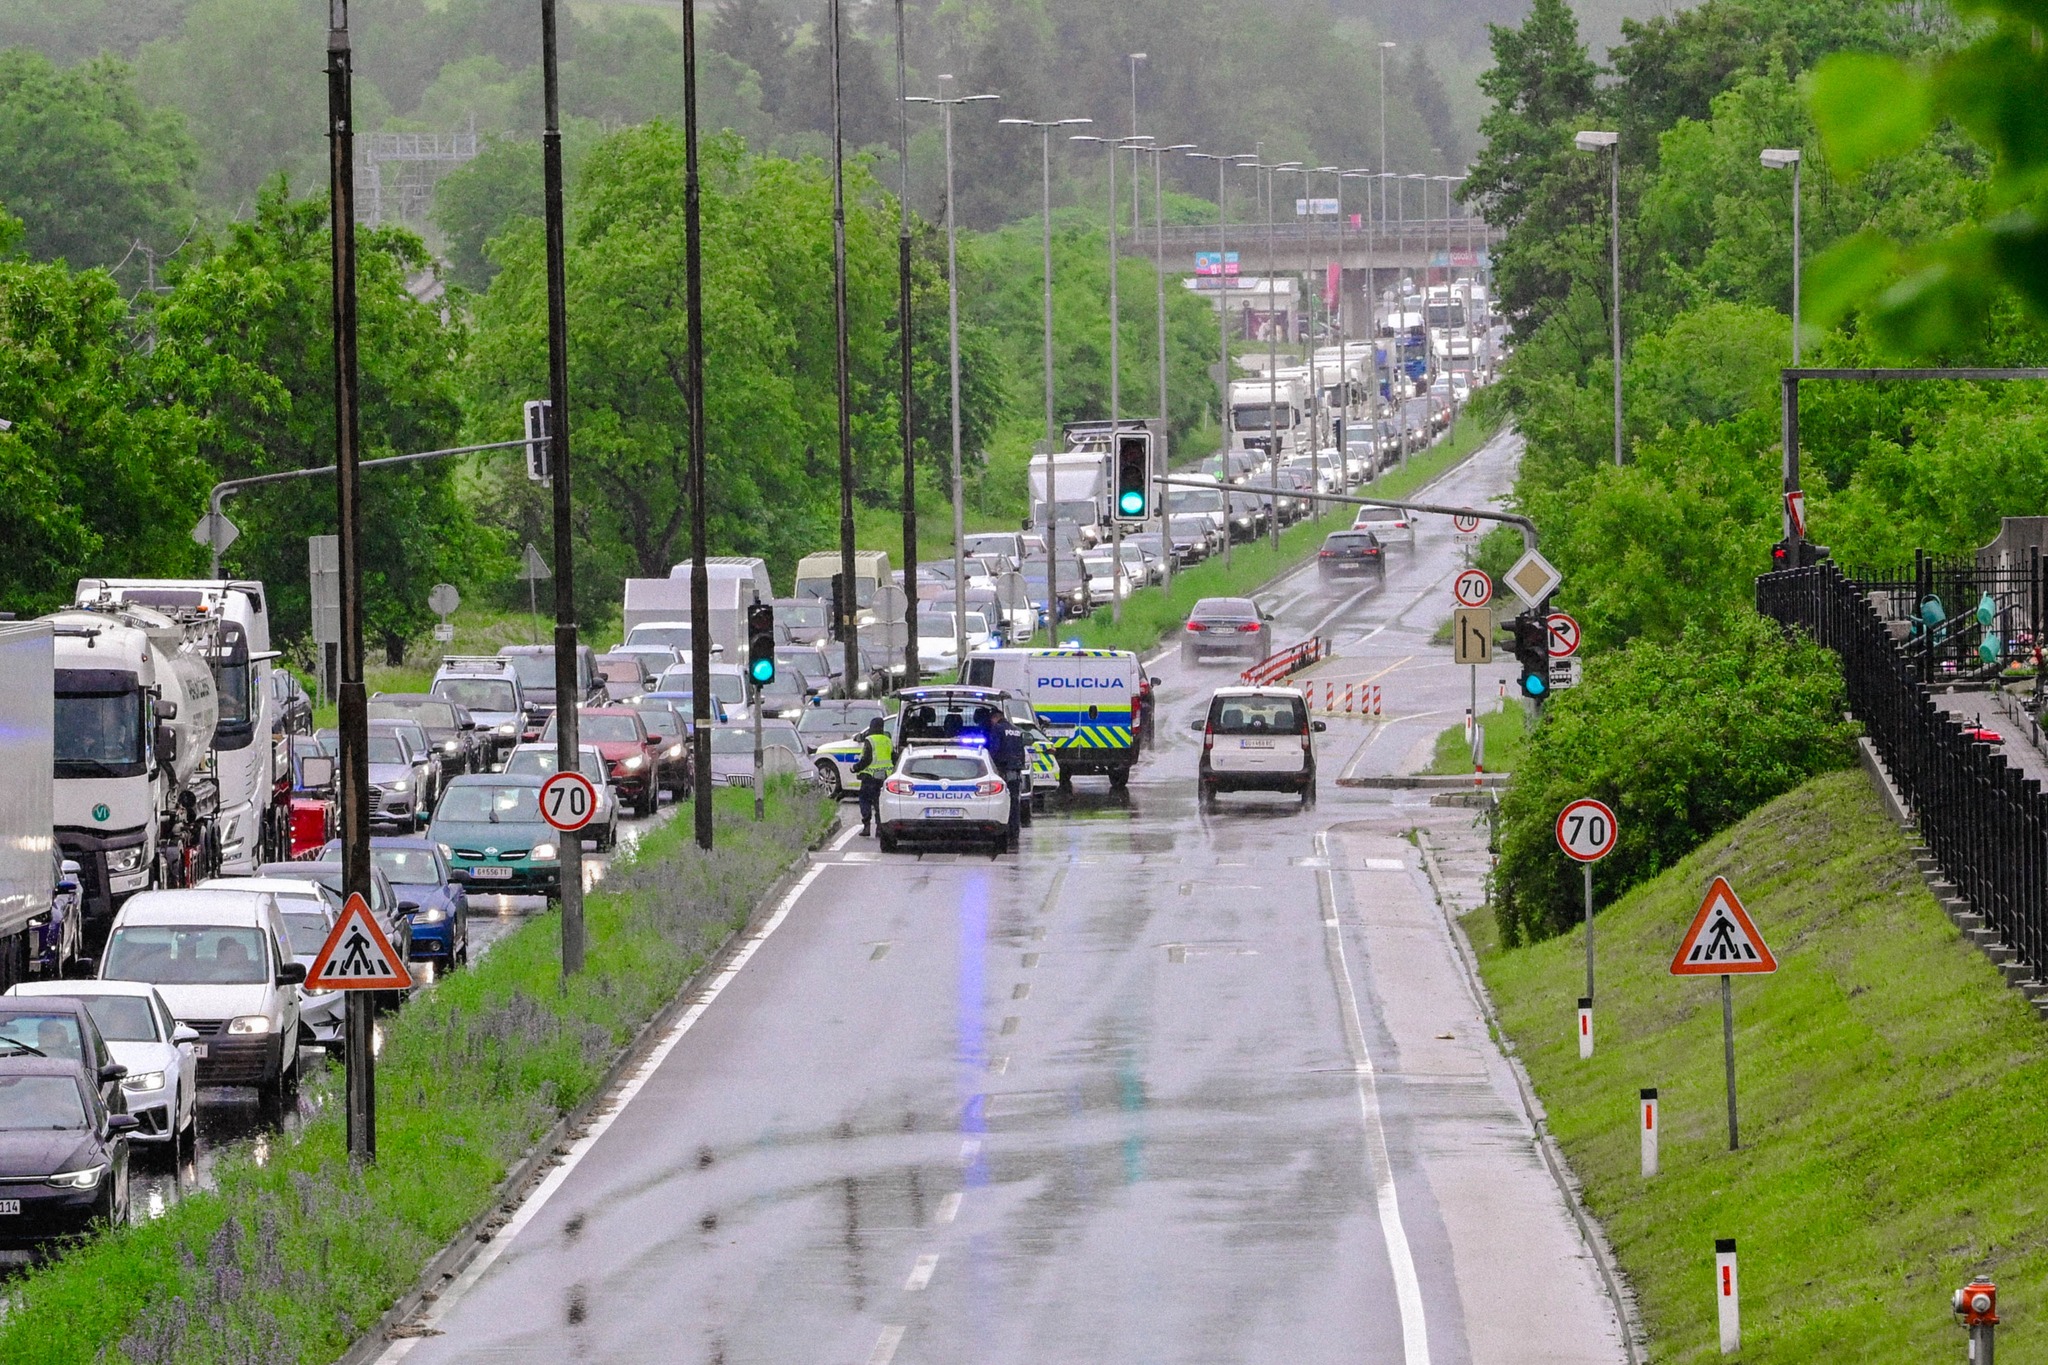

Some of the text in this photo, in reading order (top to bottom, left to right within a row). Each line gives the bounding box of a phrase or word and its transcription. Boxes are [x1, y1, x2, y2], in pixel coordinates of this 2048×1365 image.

[1461, 579, 1484, 598] 70
[1037, 677, 1124, 689] POLICIJA
[550, 786, 586, 816] 70
[917, 792, 973, 800] POLICIJA
[1568, 815, 1605, 847] 70
[0, 1201, 18, 1213] 114
